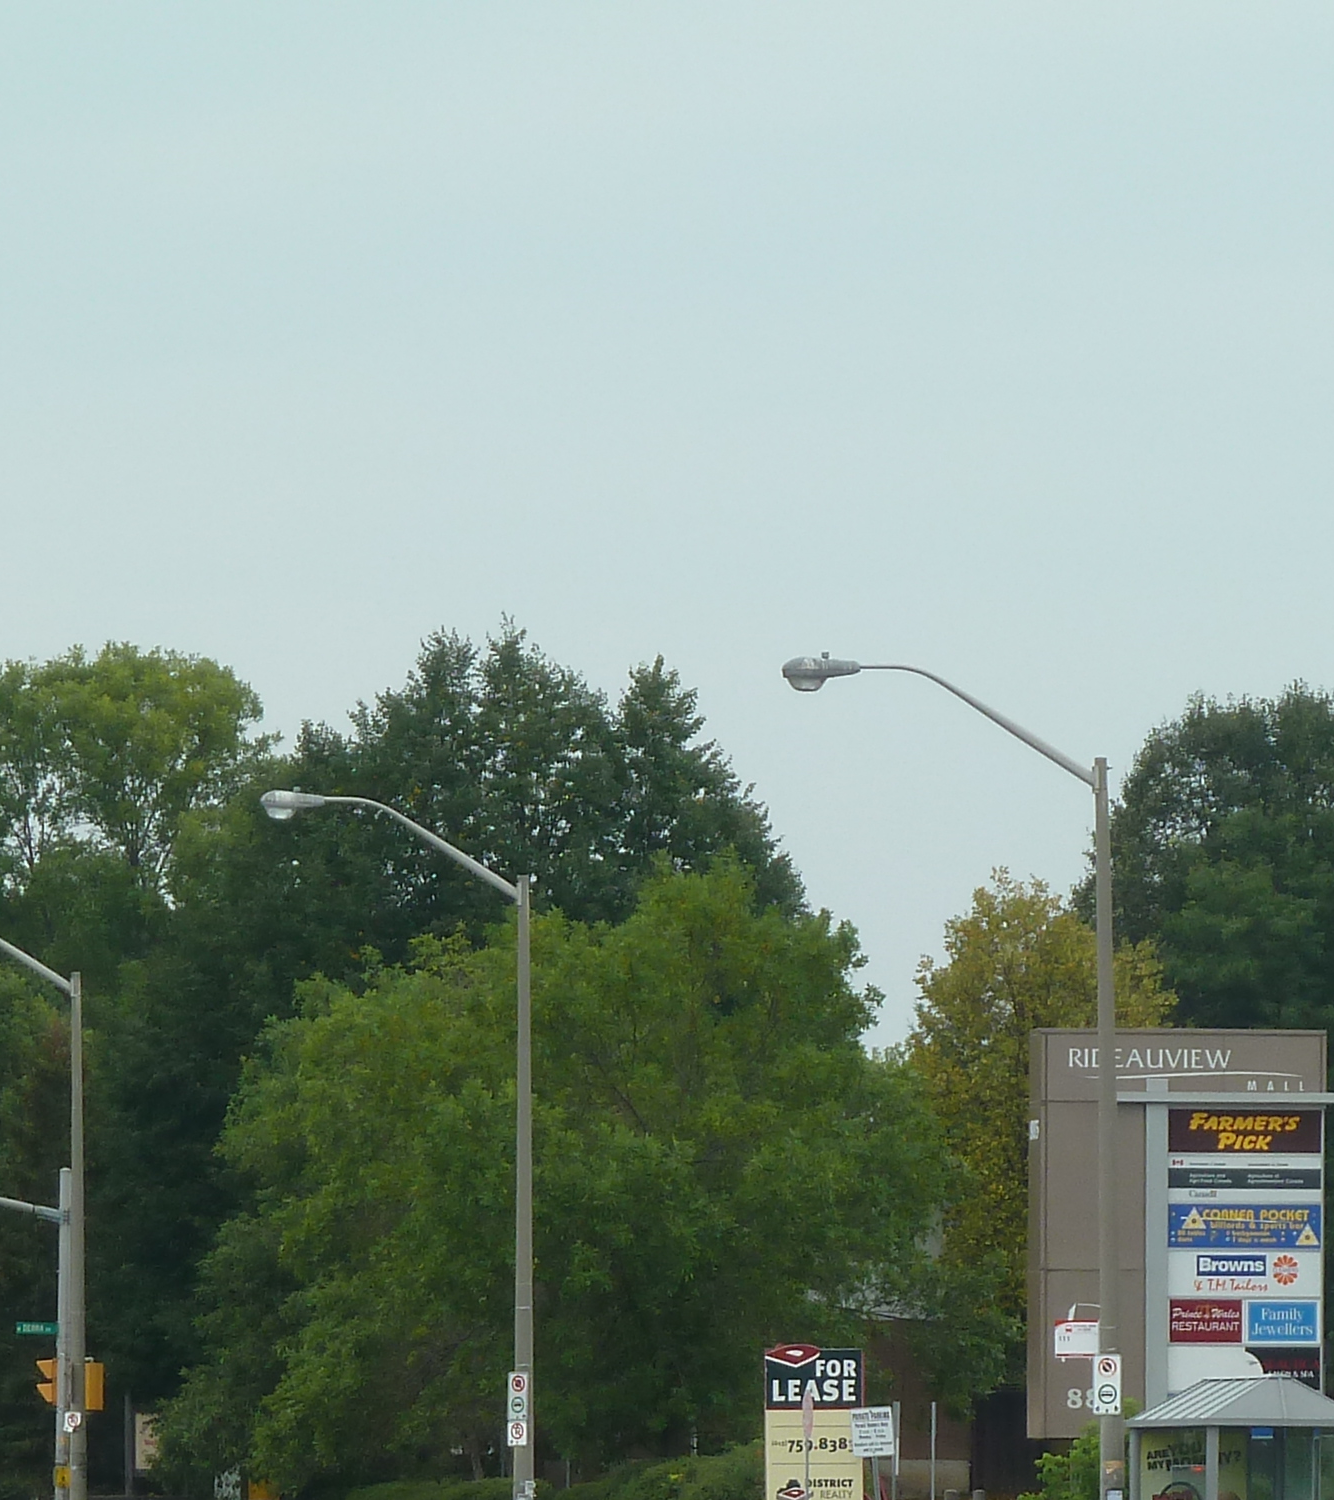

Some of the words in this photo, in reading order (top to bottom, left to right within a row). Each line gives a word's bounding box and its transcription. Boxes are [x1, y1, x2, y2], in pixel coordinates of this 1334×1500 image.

[1247, 1080, 1305, 1092] MALL
[1189, 1112, 1300, 1132] FARMER'S
[1217, 1132, 1273, 1151] PICK
[1203, 1209, 1254, 1221] CORNER
[1260, 1209, 1309, 1222] POCKET
[1199, 1257, 1264, 1272] Browns
[1230, 1278, 1269, 1292] Tailors
[1172, 1307, 1203, 1319] Prince
[1211, 1307, 1240, 1319] Wales
[1261, 1307, 1305, 1322] Family
[1172, 1321, 1240, 1332] RESTAURANT
[1252, 1322, 1313, 1336] Jewellers
[815, 1359, 857, 1378] FOR
[772, 1379, 857, 1402] LEASE
[820, 1490, 854, 1500] REALTY
